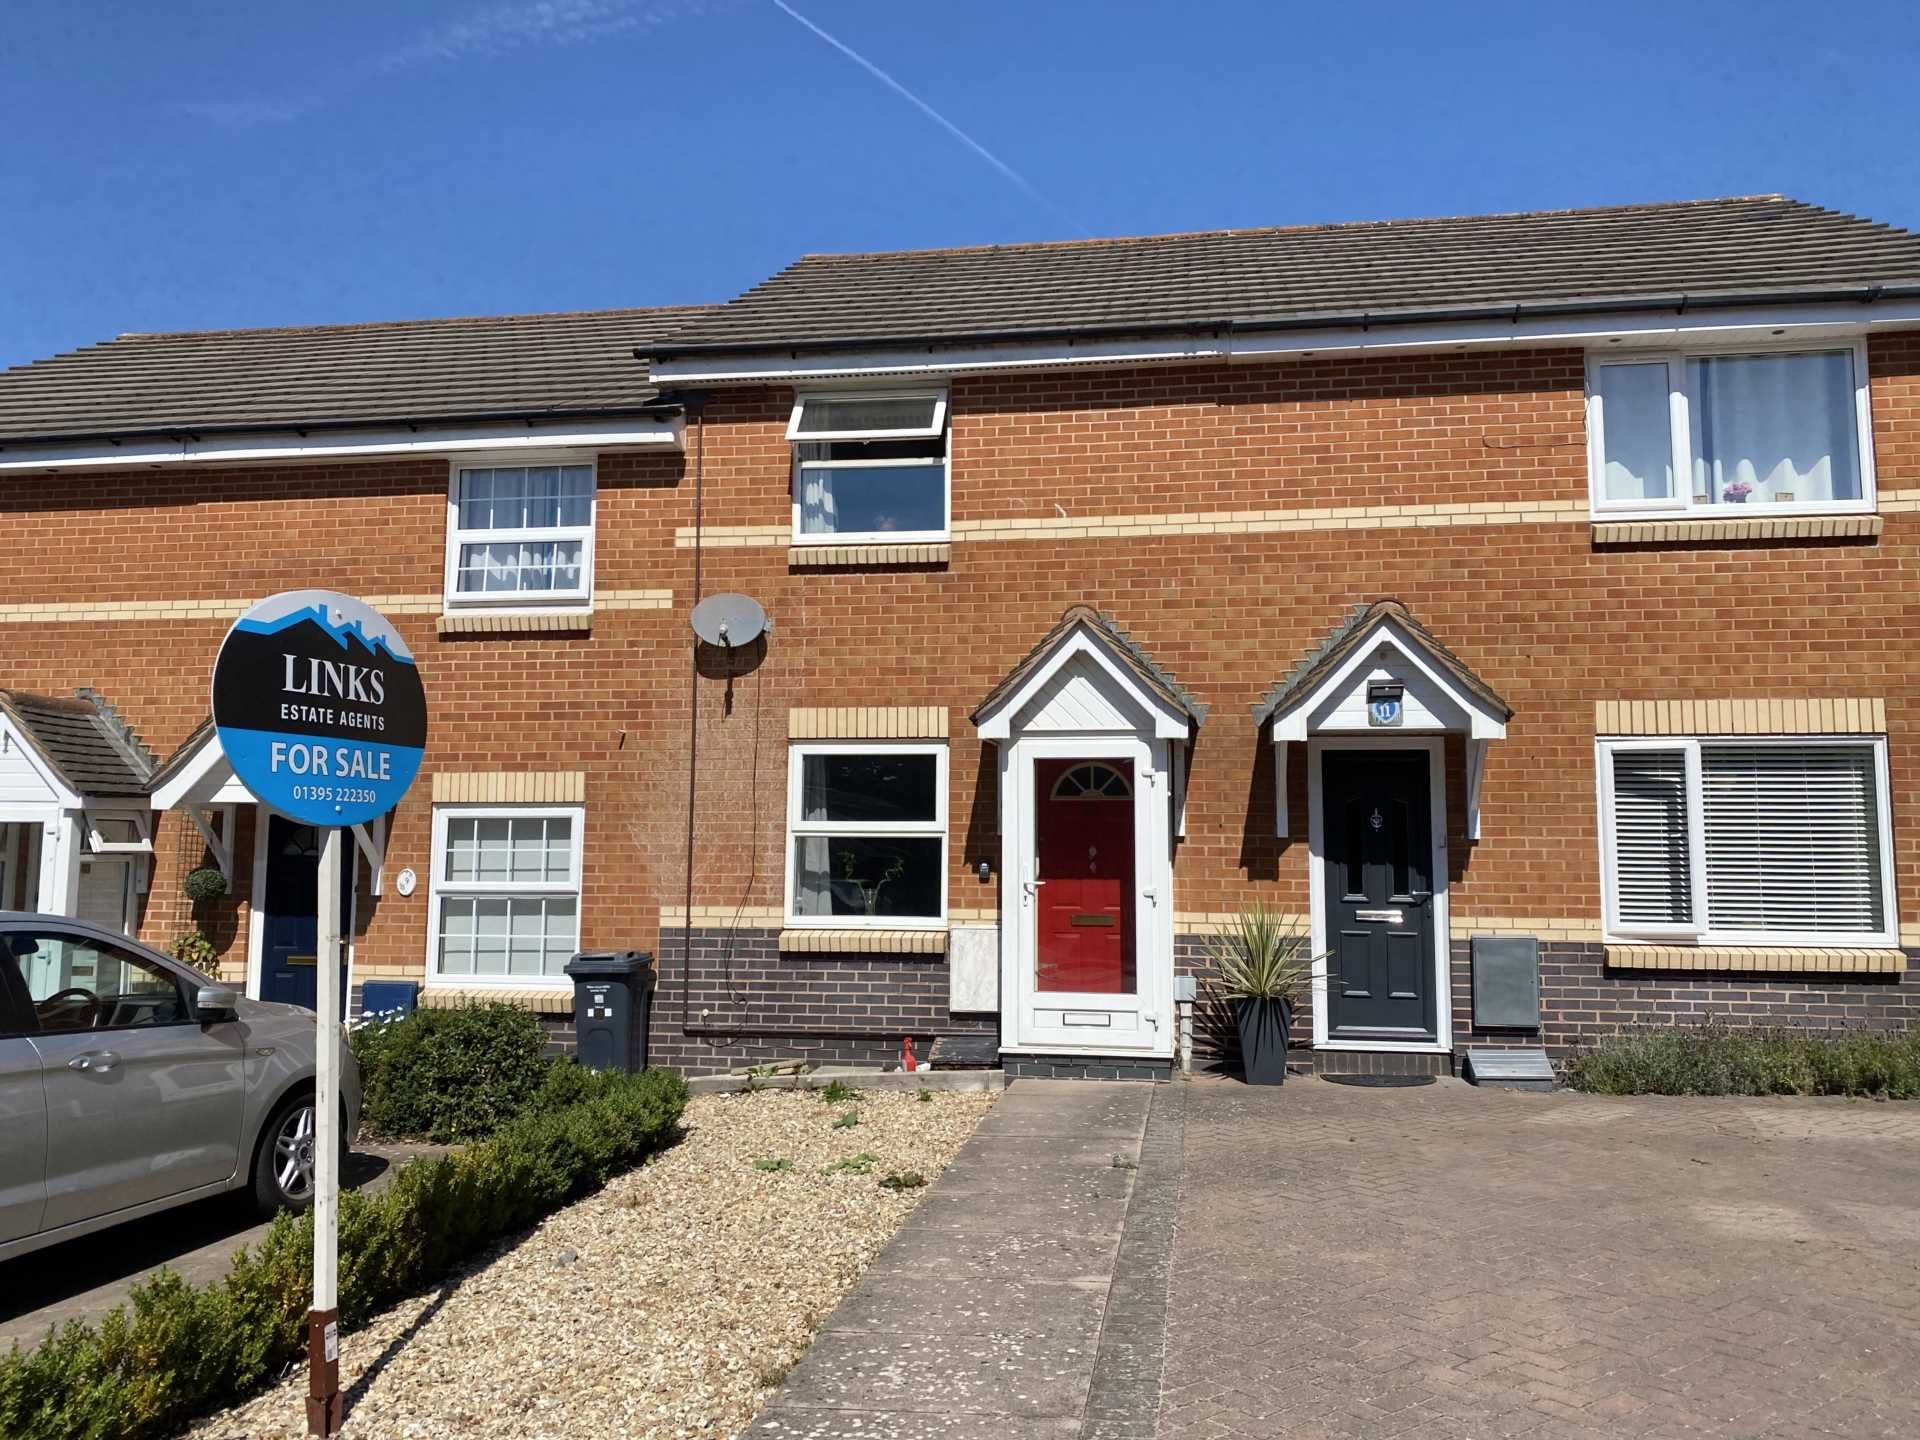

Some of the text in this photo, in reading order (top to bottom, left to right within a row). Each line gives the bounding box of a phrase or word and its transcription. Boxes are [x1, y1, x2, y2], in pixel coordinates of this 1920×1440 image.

[282, 653, 385, 705] LINKS
[281, 704, 385, 731] ESTATE AGENTS
[271, 741, 391, 781] FOR SALE
[293, 786, 376, 803] 01395 222350
